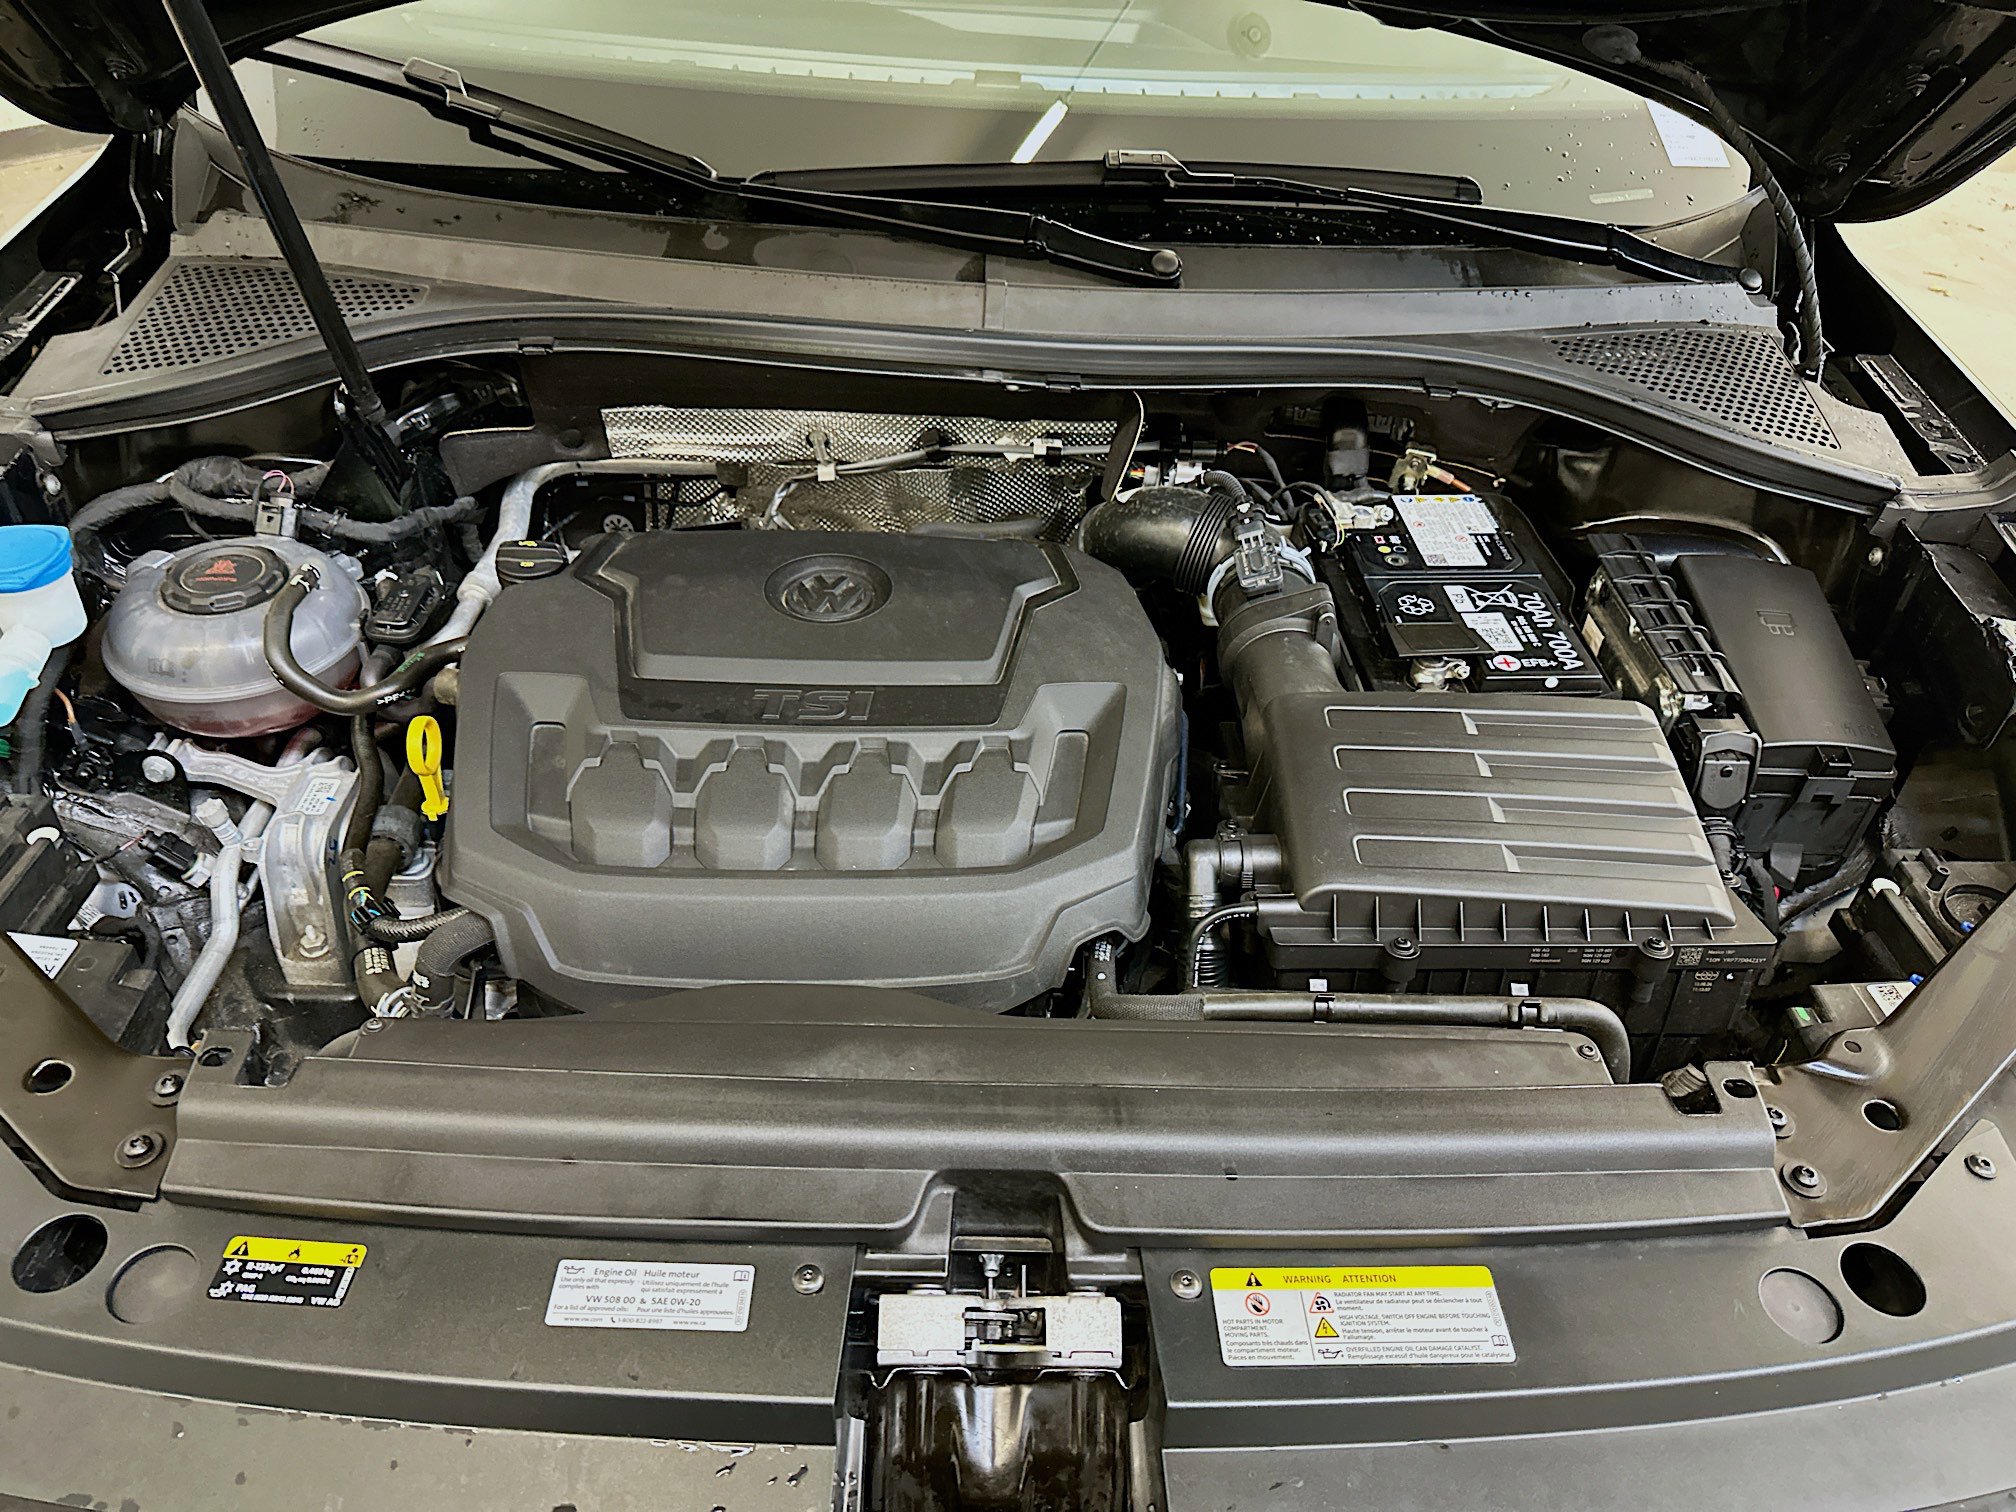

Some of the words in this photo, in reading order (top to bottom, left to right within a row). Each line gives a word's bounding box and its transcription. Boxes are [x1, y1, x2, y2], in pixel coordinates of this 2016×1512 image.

[1518, 592, 1556, 628] 70Ah
[1542, 631, 1584, 670] 700A
[752, 689, 875, 721] TSI
[594, 1268, 622, 1277] Engine
[1283, 1275, 1332, 1284] WARNING
[1342, 1274, 1397, 1283] ATTENTION
